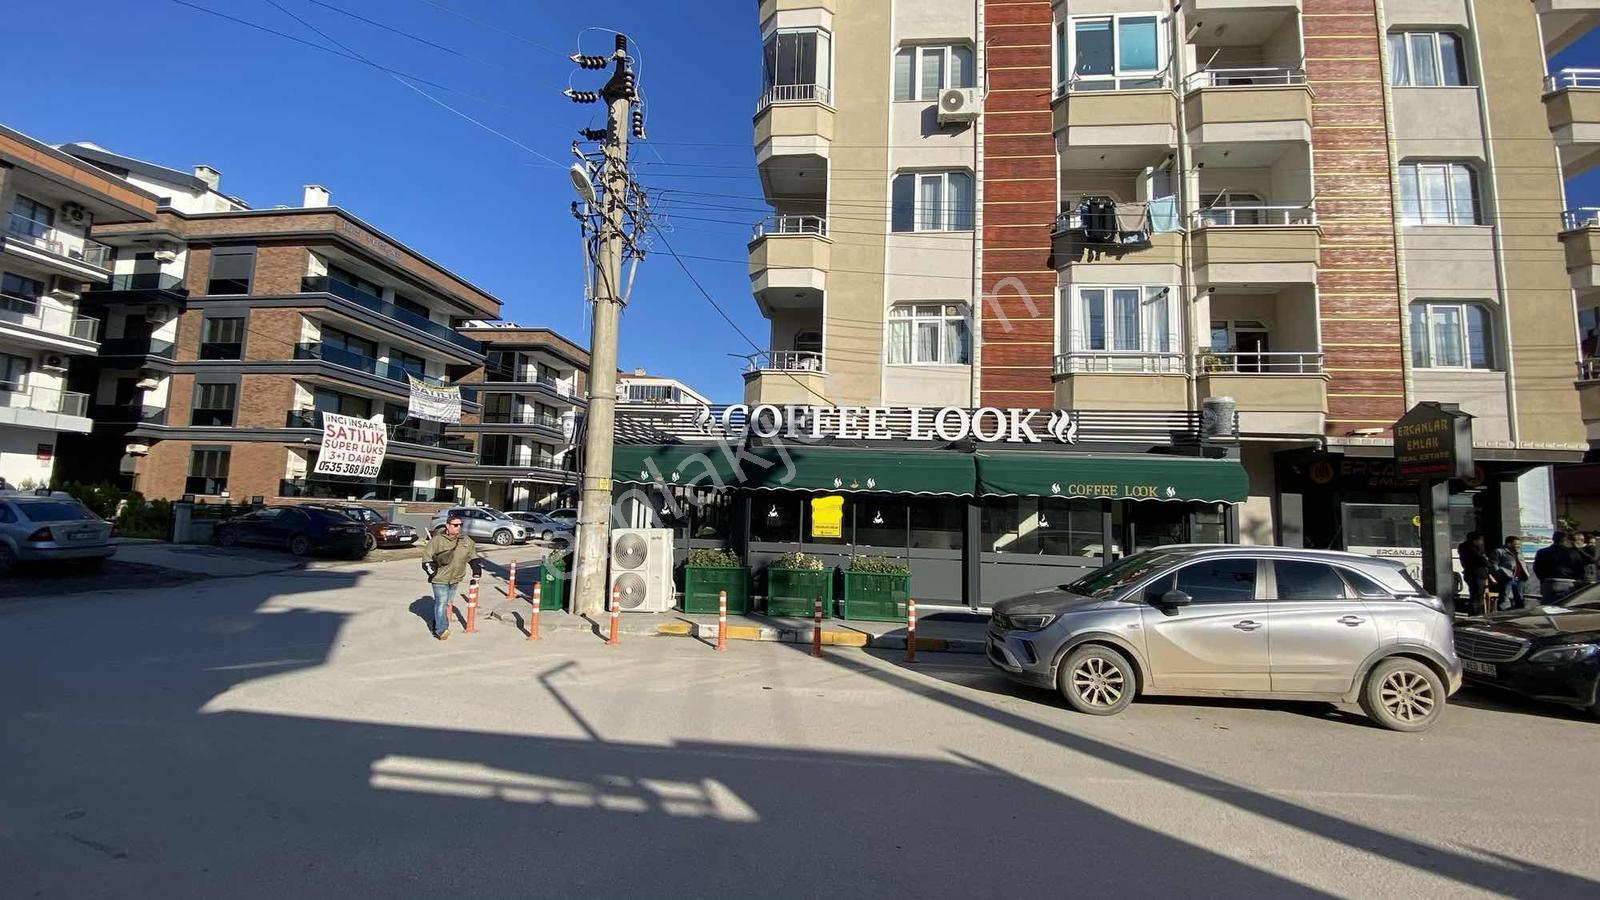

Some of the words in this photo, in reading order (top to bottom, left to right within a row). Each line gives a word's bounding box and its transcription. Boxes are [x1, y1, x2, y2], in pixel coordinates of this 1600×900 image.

[721, 404, 892, 440] COFFEE
[906, 406, 1042, 443] LOOK
[1397, 418, 1449, 437] ERCANLAR
[325, 424, 386, 446] SATILIK
[1407, 436, 1440, 449] EMLAK
[328, 450, 346, 461] 3+1
[318, 460, 343, 473] 0535
[343, 463, 360, 475] 368
[1068, 483, 1118, 496] COFFEE
[1124, 485, 1159, 498] LOOK
